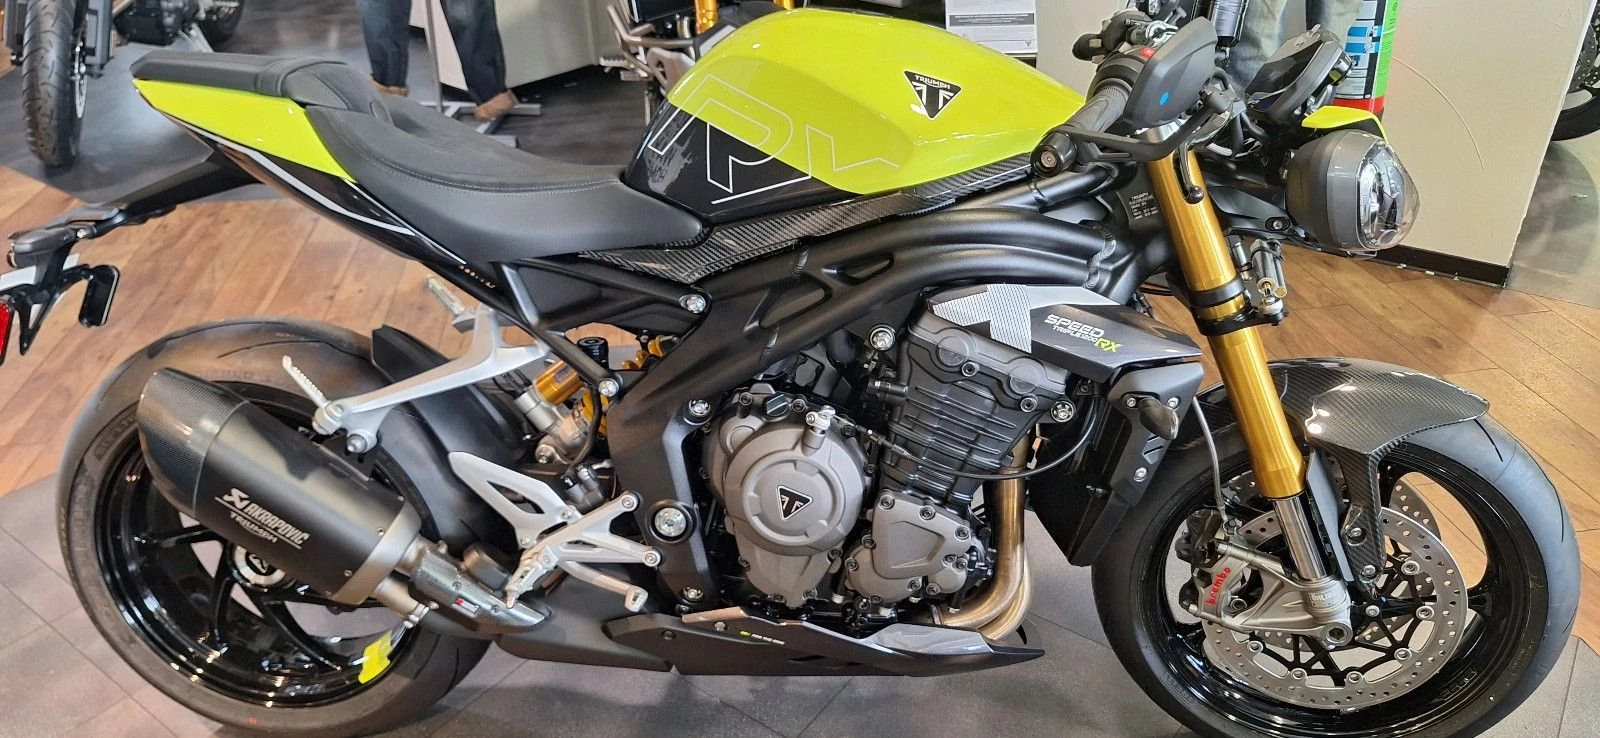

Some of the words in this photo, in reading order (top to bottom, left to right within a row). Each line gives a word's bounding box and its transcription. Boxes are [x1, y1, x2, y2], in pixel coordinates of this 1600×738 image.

[914, 74, 951, 90] TRIUMPH
[1044, 313, 1105, 338] SPEED
[1094, 337, 1123, 353] RX
[230, 510, 278, 544] TRIUMPH
[1204, 566, 1231, 606] brembo
